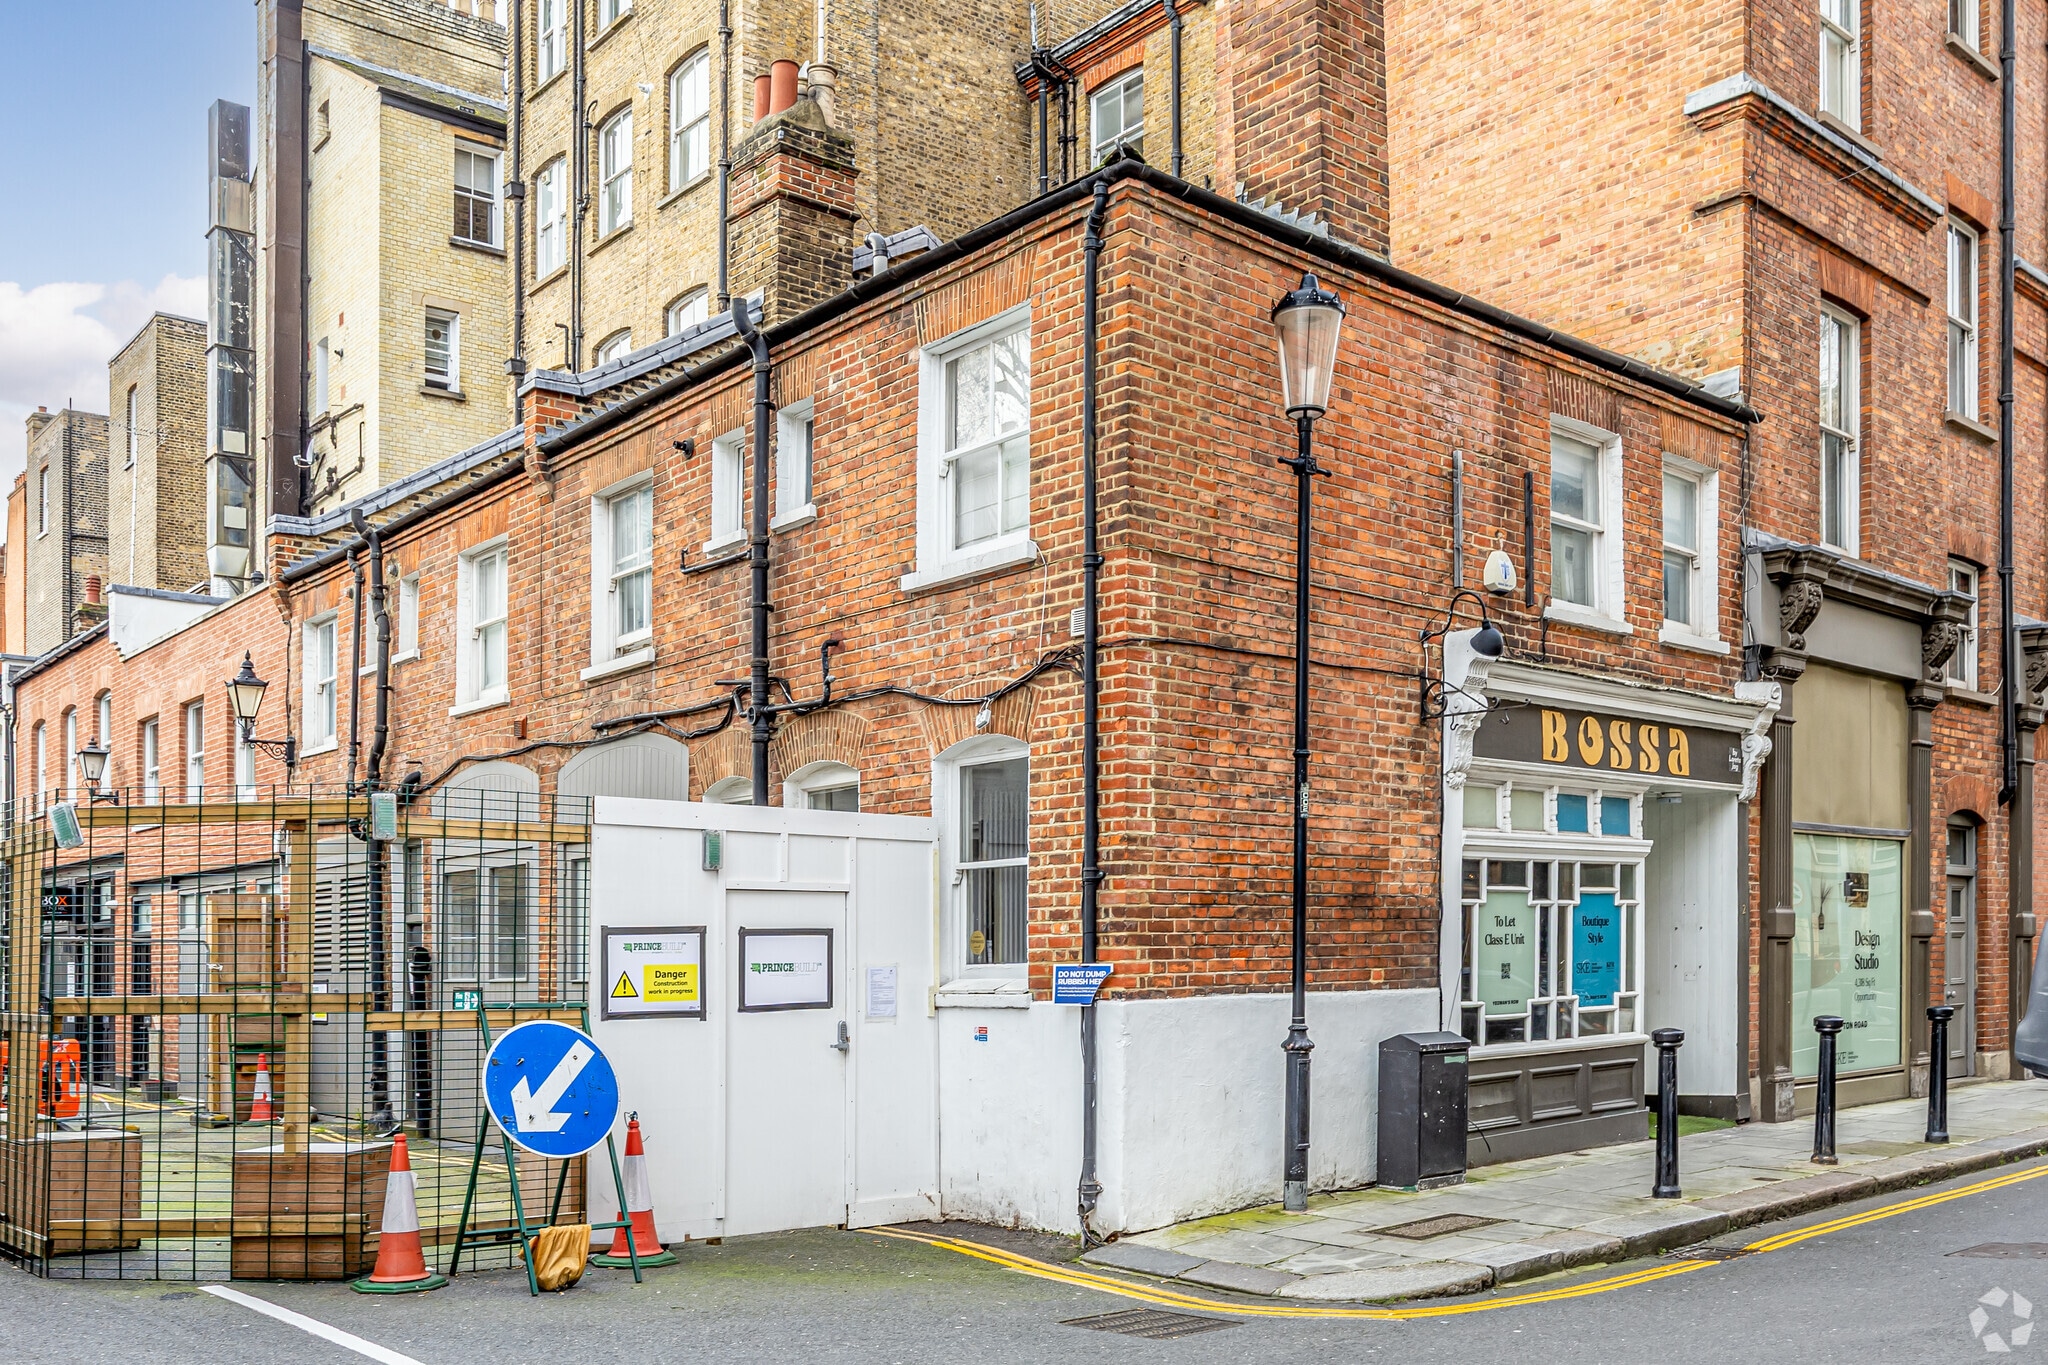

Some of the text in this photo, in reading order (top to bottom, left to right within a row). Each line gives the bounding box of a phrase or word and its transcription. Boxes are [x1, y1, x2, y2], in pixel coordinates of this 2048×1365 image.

[1494, 915, 1516, 927] To Let
[1582, 915, 1609, 928] Boutique
[1485, 933, 1525, 945] Class E Unit
[1588, 932, 1604, 945] Style
[1854, 930, 1880, 950] Design
[1854, 953, 1879, 970] Studio
[1576, 962, 1590, 974] SKE
[655, 970, 687, 980] Danger
[1854, 1020, 1868, 1028] ROAD
